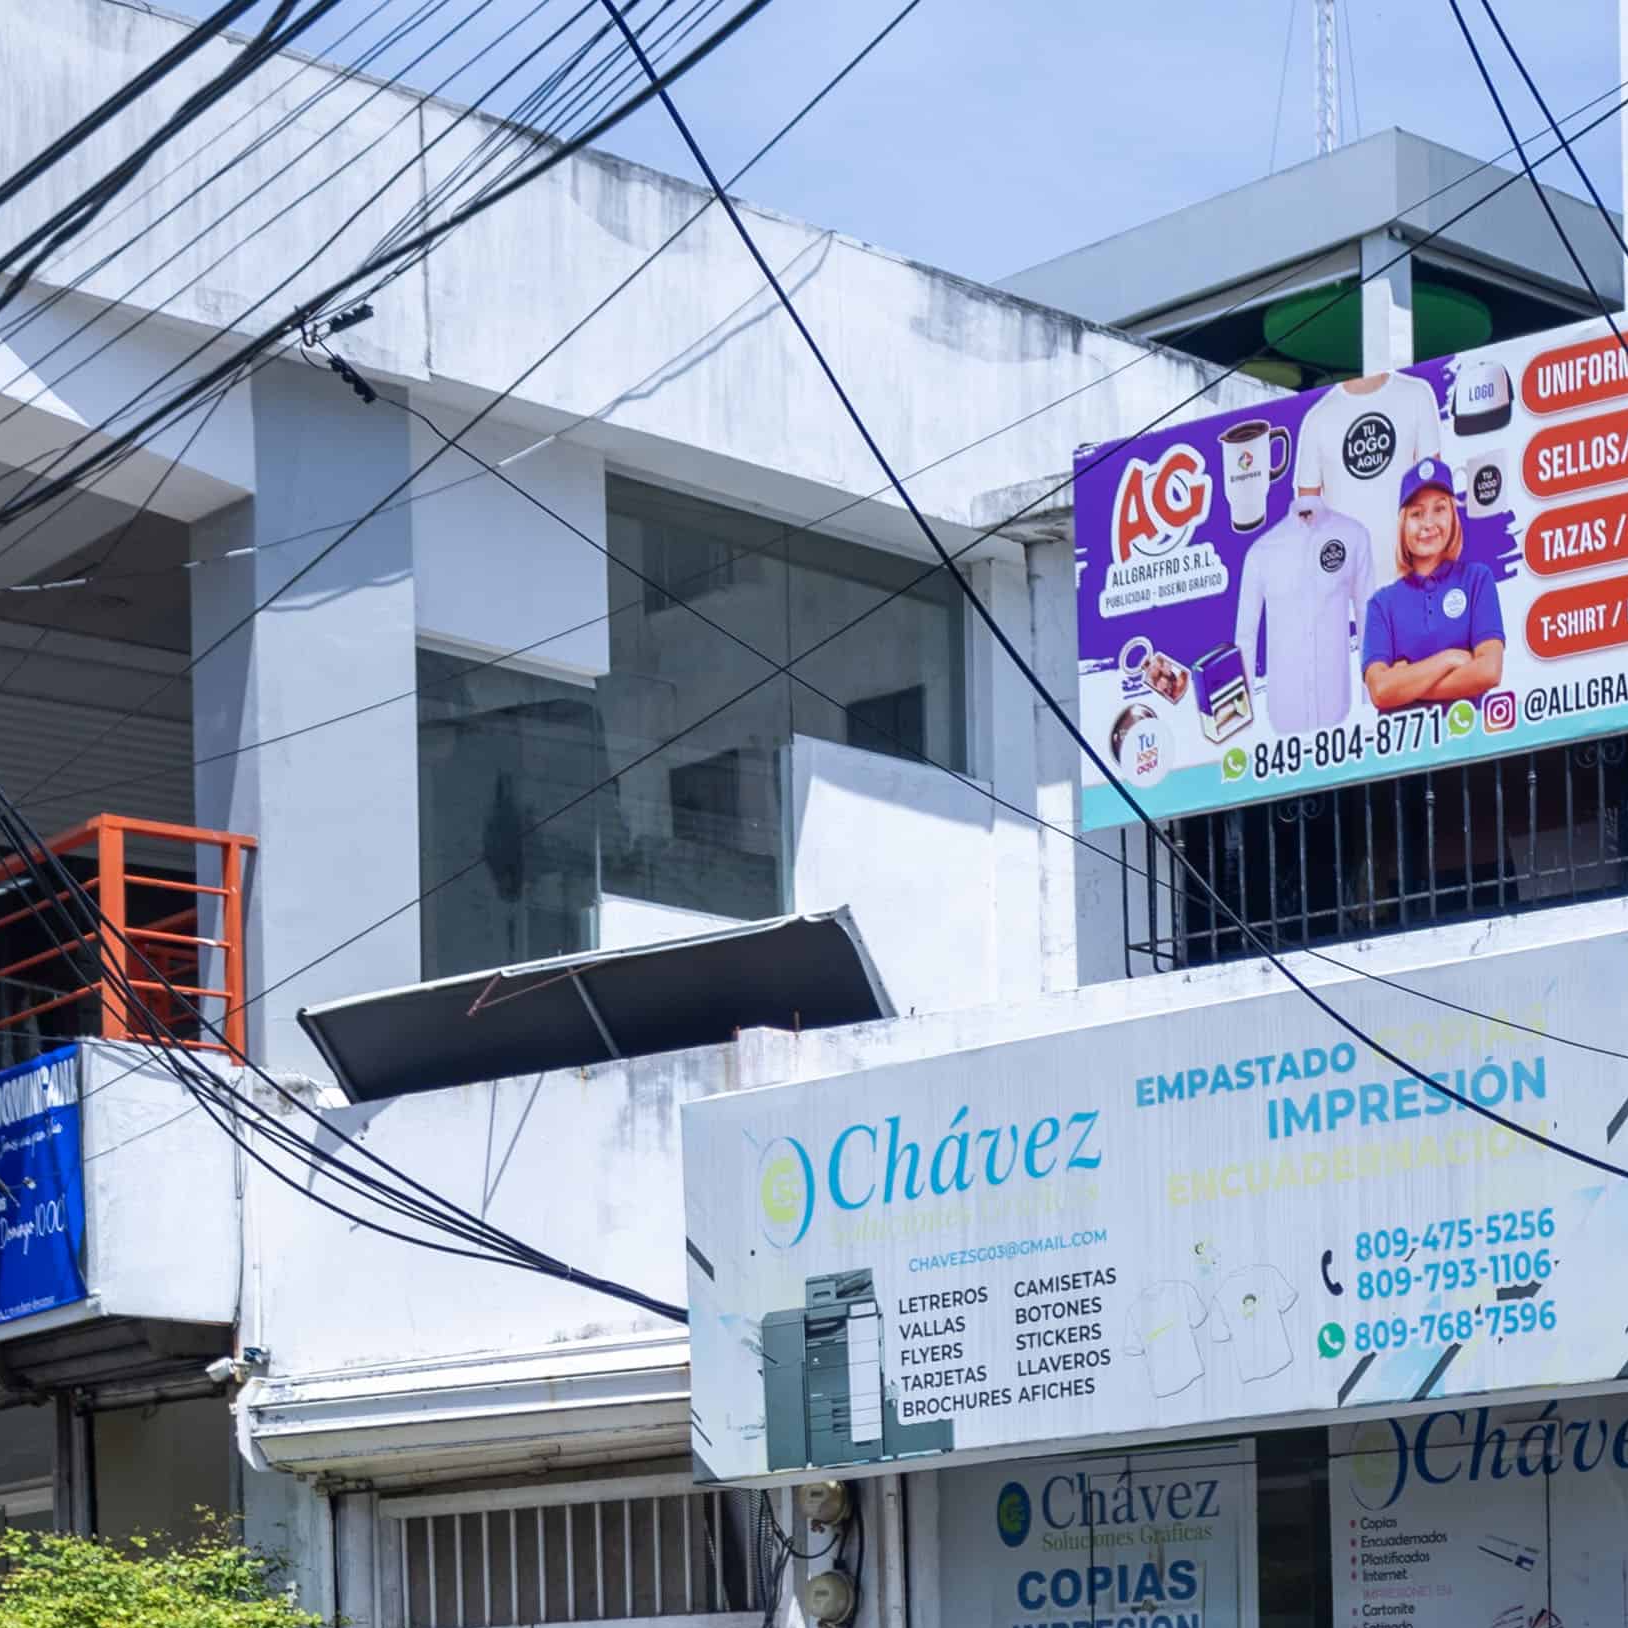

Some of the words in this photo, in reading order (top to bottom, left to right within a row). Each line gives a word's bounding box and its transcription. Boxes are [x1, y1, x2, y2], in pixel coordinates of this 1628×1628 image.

[1468, 383, 1495, 401] LOGO
[1362, 423, 1376, 436] TU
[1347, 433, 1391, 457] LOGO
[1356, 452, 1384, 469] AQUI
[1540, 518, 1607, 561] TAZAS
[1112, 557, 1180, 588] ALLGRAFFRD
[1540, 603, 1607, 641] T-SHIRT
[1253, 709, 1442, 780] 849-804-8771
[1135, 1042, 1357, 1108] EMPASTADO
[1268, 1055, 1548, 1140] IMPRESIÓN
[828, 1105, 1102, 1211] Chávez
[1355, 1207, 1555, 1262] 809-475-5256
[1014, 1267, 1117, 1298] CAMISETAS
[1356, 1249, 1552, 1301] 809-793-1106
[898, 1286, 989, 1315] LETREROS
[1015, 1297, 1102, 1324] BOTONES
[899, 1316, 966, 1340] VALLAS
[1016, 1323, 1102, 1350] STICKERS
[1354, 1300, 1557, 1352] 809-768-7596
[901, 1342, 964, 1366] FLYERS
[1017, 1349, 1111, 1376] LLAVEROS
[901, 1365, 987, 1392] TARJETAS
[902, 1388, 1012, 1418] BROCHURES
[1018, 1377, 1096, 1404] AFICHES
[1042, 1470, 1221, 1530] Chávez
[1042, 1529, 1134, 1552] Soluciones
[1140, 1523, 1214, 1545] Gráficas
[1360, 1517, 1398, 1532] Copias
[1361, 1550, 1431, 1567] Plastificados
[1017, 1559, 1198, 1611] COPIAS
[1362, 1569, 1408, 1583] Internet
[1362, 1603, 1415, 1618] Cartonite
